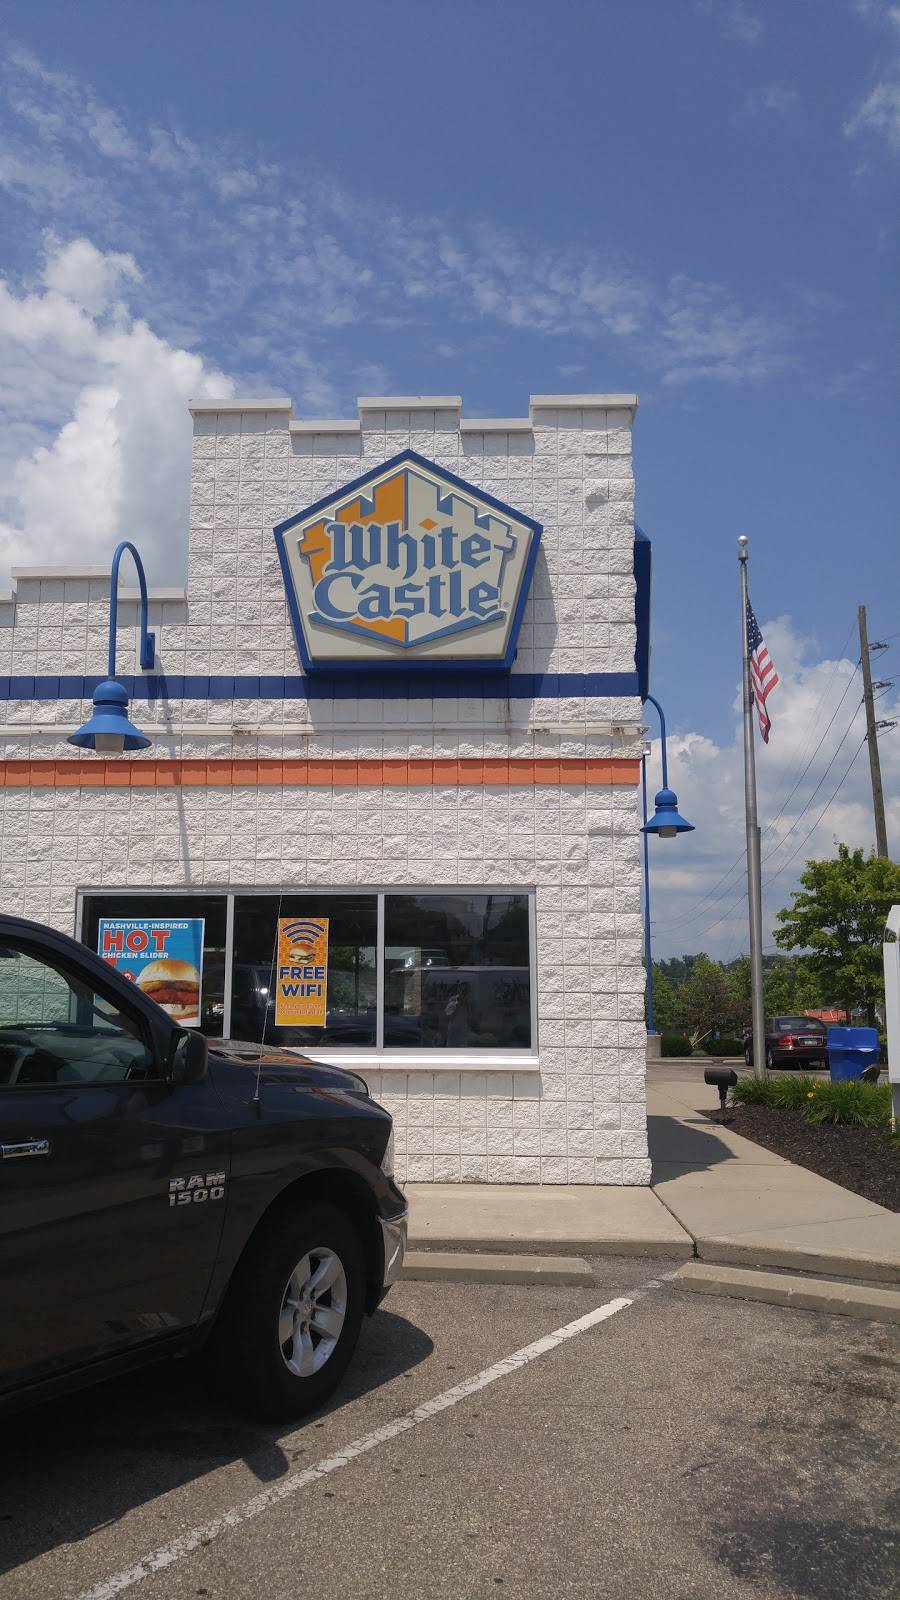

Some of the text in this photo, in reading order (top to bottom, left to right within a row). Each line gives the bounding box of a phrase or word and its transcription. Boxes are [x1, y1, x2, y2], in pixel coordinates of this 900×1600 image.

[325, 523, 491, 578] White
[315, 571, 499, 618] Castle
[103, 930, 171, 952] HOT
[280, 966, 325, 979] FREE
[282, 984, 322, 997] WIFI
[169, 1171, 225, 1192] RAM
[168, 1187, 225, 1207] 1500
